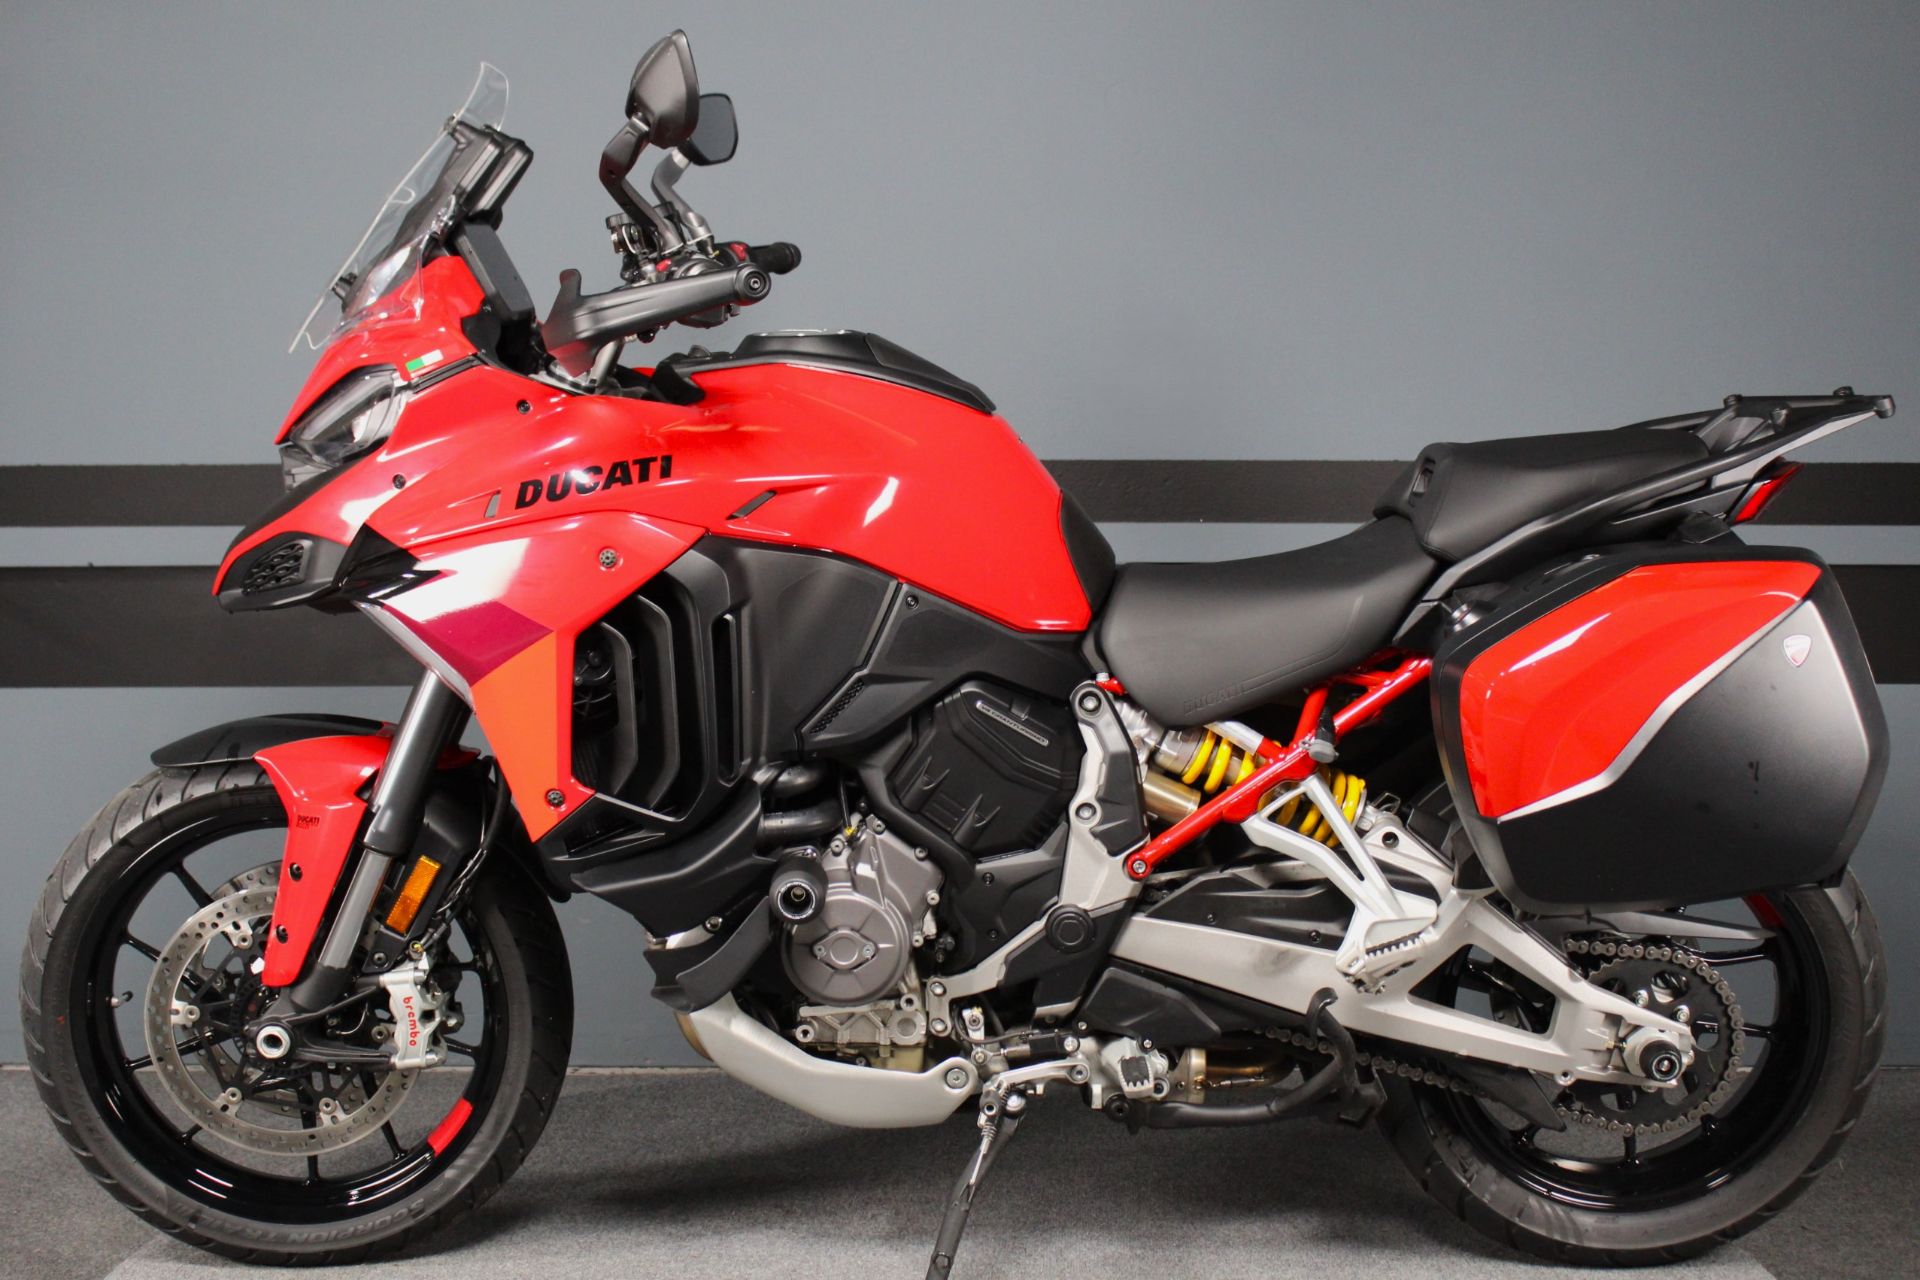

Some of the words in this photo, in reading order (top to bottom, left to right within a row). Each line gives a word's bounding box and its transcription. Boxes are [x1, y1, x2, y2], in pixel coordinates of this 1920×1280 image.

[515, 454, 673, 510] DUCATI
[403, 996, 420, 1047] brembo
[286, 1198, 425, 1243] SCORPION
